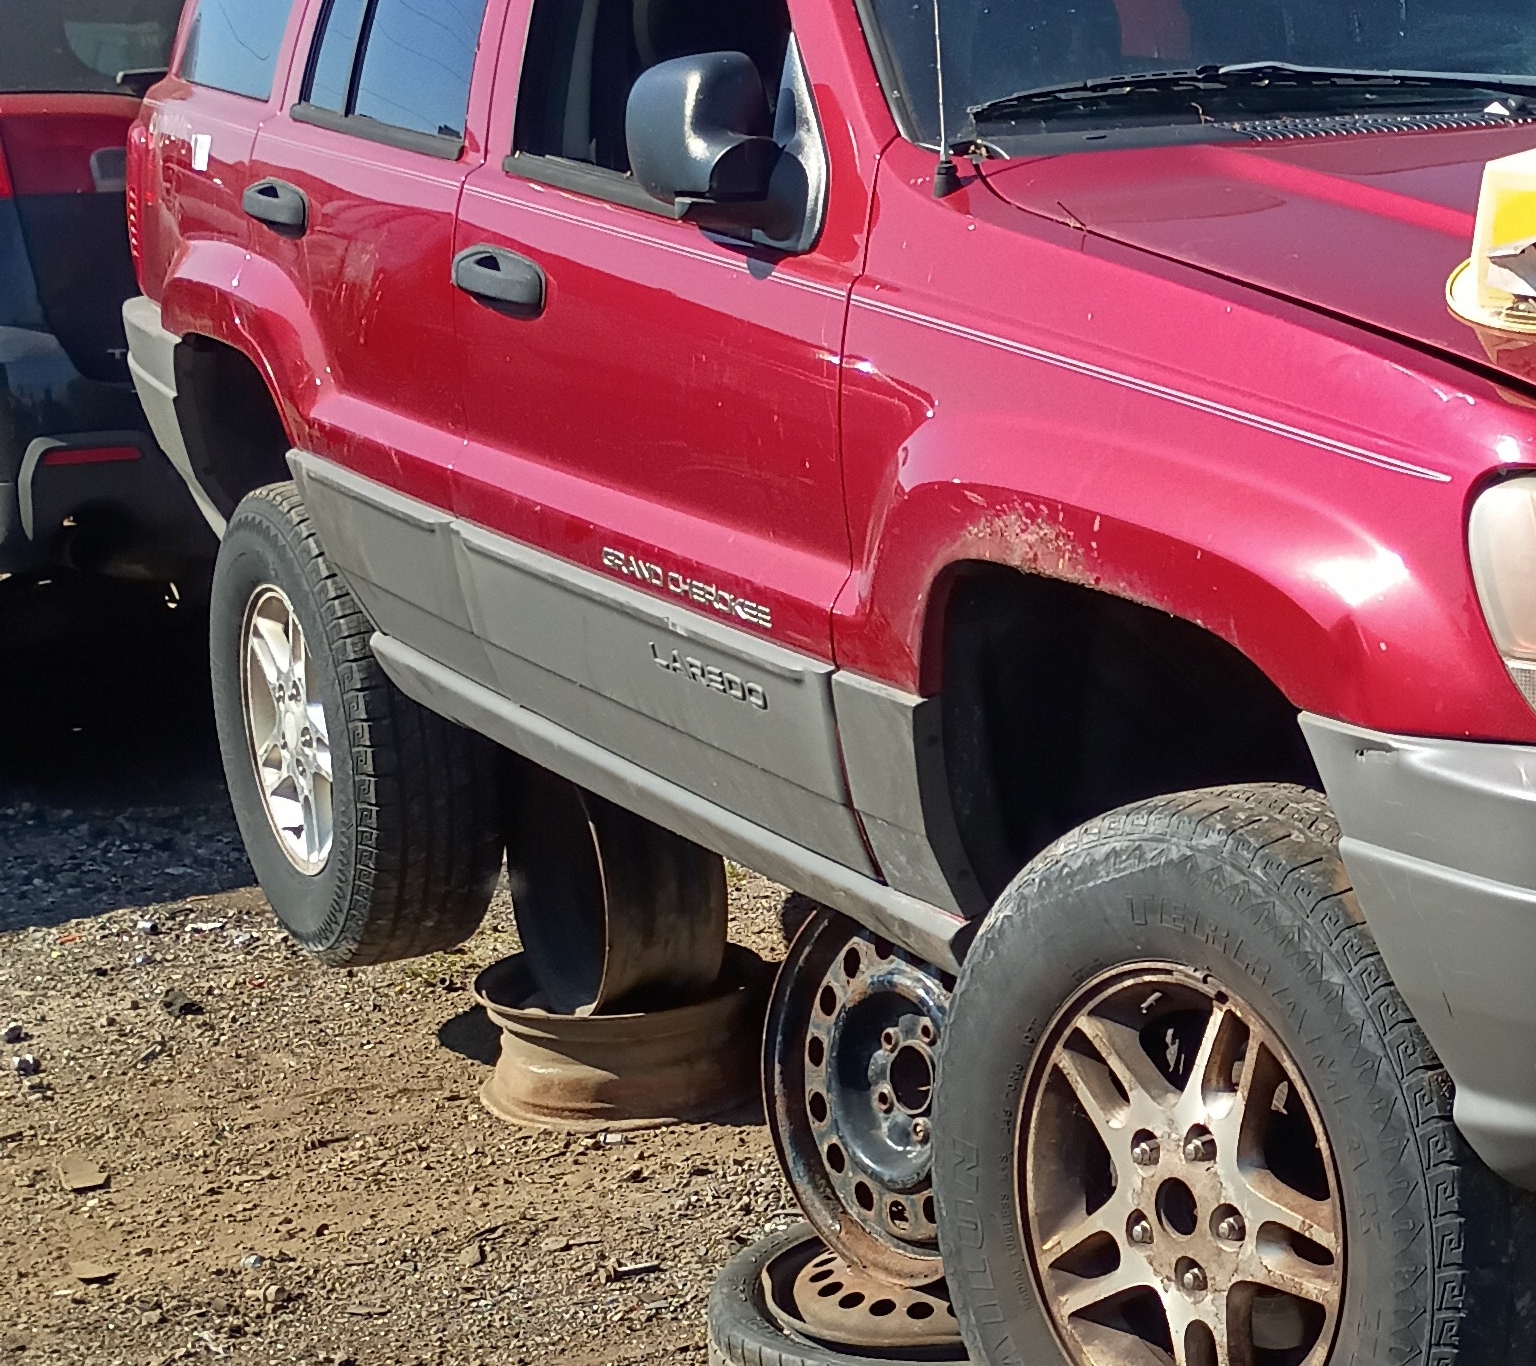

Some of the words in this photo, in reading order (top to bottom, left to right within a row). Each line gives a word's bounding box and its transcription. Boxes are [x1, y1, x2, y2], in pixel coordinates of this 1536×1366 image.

[602, 546, 664, 588] GRAND
[667, 572, 773, 629] CHEROKEE
[648, 641, 769, 711] LAREDO
